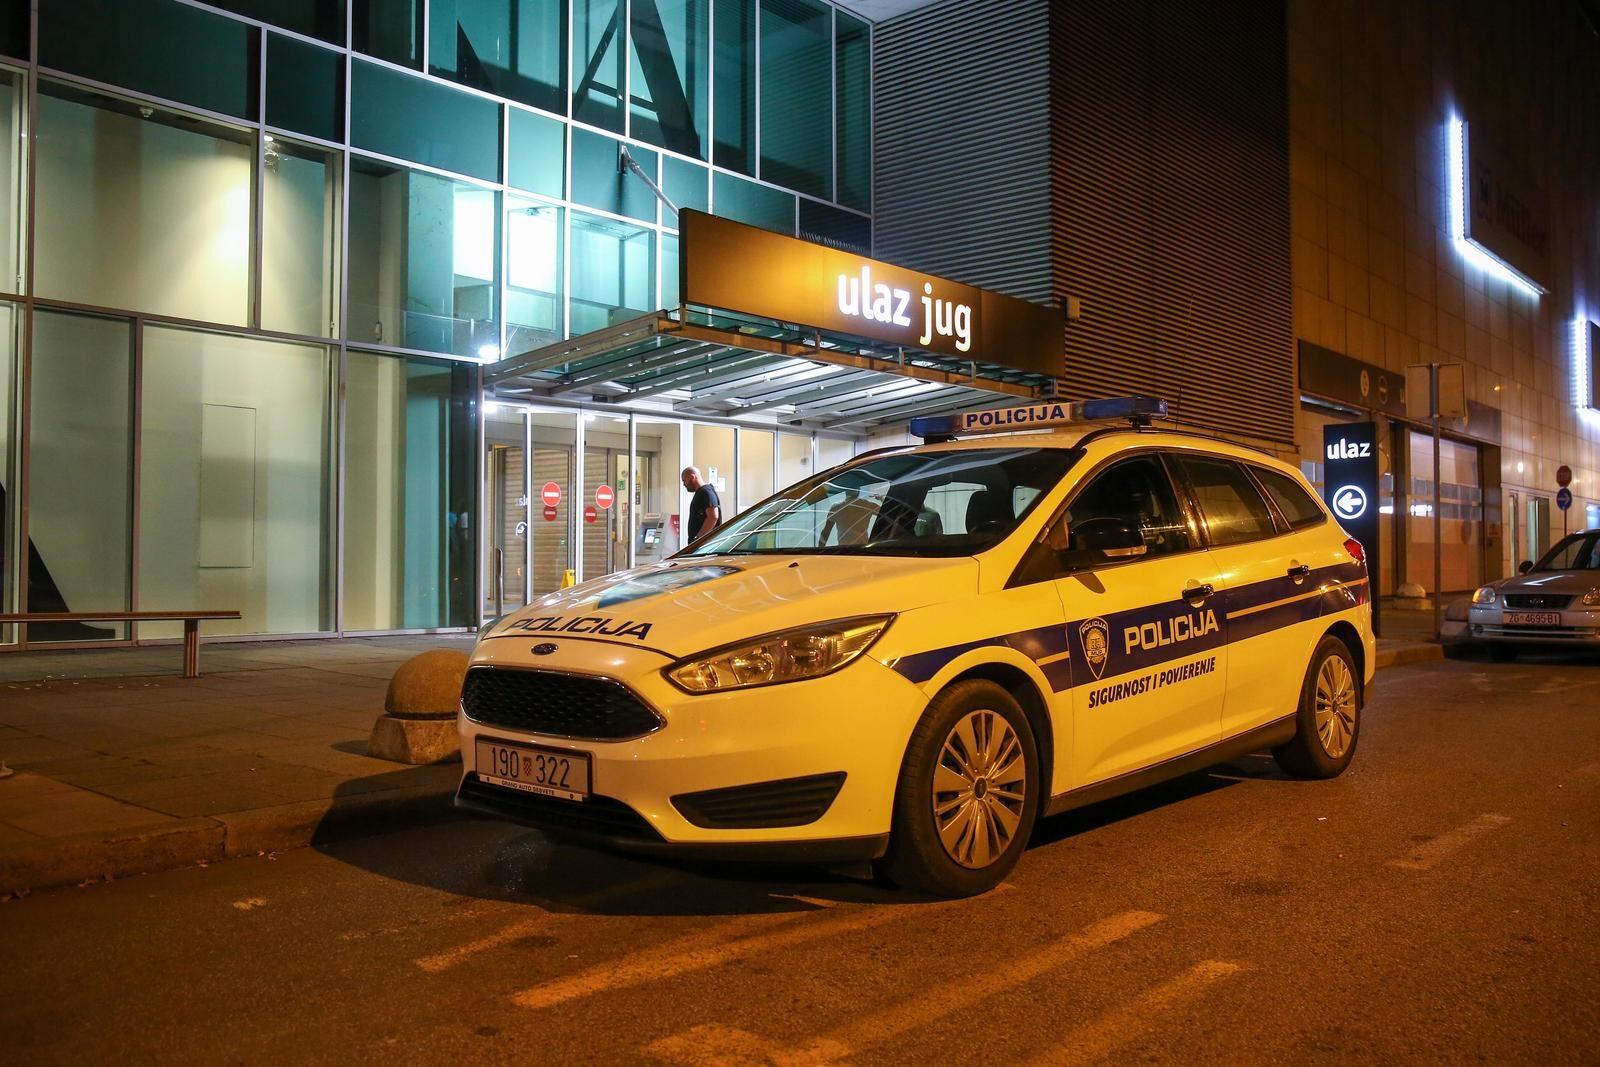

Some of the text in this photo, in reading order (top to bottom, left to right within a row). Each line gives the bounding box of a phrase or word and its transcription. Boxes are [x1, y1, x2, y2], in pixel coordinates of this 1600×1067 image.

[838, 265, 972, 352] ulaz jug
[966, 404, 1066, 427] POLICIJA
[1326, 437, 1371, 460] ulaz
[503, 616, 654, 641] POLICIJA
[1081, 620, 1107, 635] POLICIJA
[1123, 609, 1220, 655] POLICIJA
[1088, 656, 1216, 709] SIGURNOST I POVJERENJE
[491, 747, 571, 788] 190 322
[518, 783, 532, 792] AUTO
